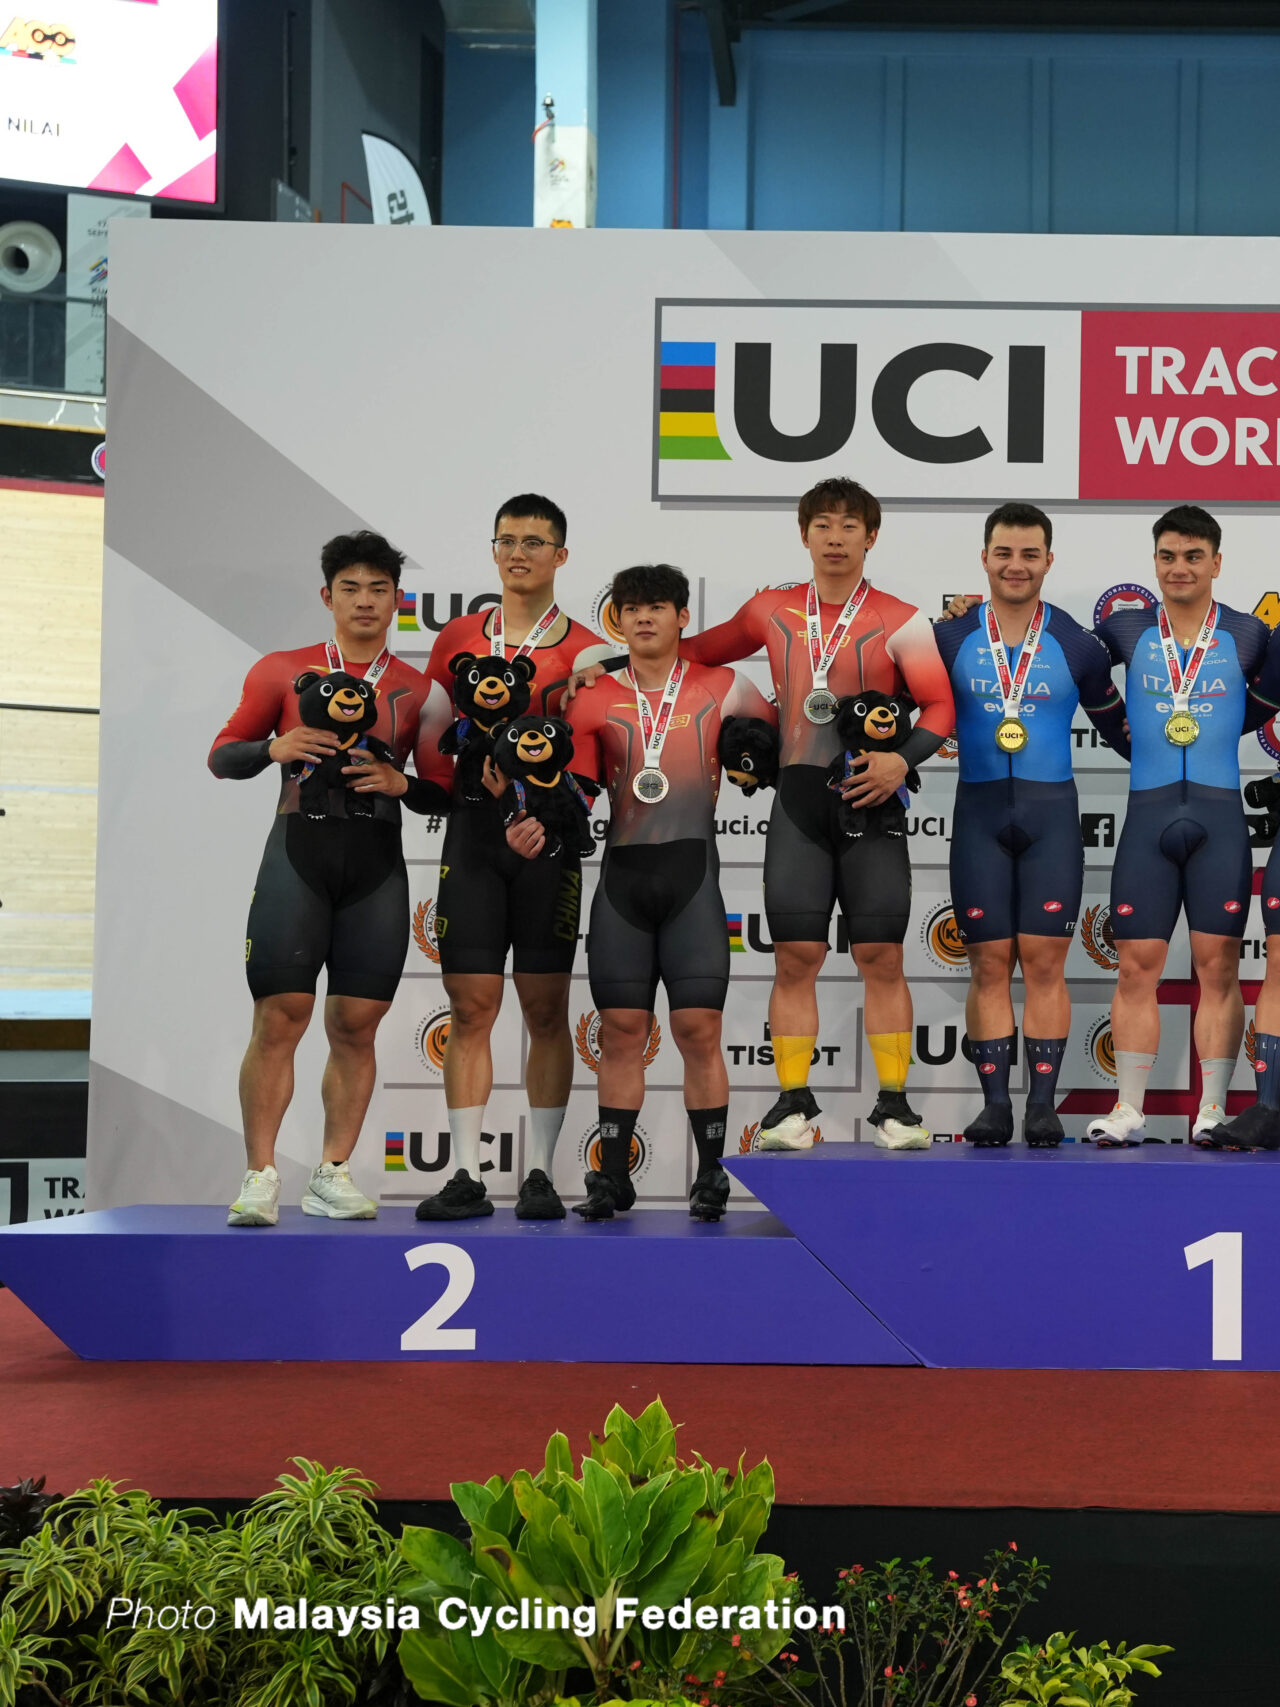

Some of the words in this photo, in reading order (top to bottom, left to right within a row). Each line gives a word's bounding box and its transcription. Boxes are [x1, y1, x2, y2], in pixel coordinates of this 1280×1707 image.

[8, 117, 60, 137] NILAI
[734, 342, 1045, 464] UCI
[1097, 585, 1127, 611] NATIONAL
[971, 678, 1051, 695] ITAIA
[1143, 674, 1226, 691] ITAIA
[984, 702, 1036, 713] evso
[1155, 702, 1213, 713] evso
[748, 913, 849, 954] UI
[727, 1045, 841, 1066] TIST
[44, 1177, 86, 1199] TR
[401, 1242, 476, 1351] 2
[1184, 1231, 1243, 1361] 1
